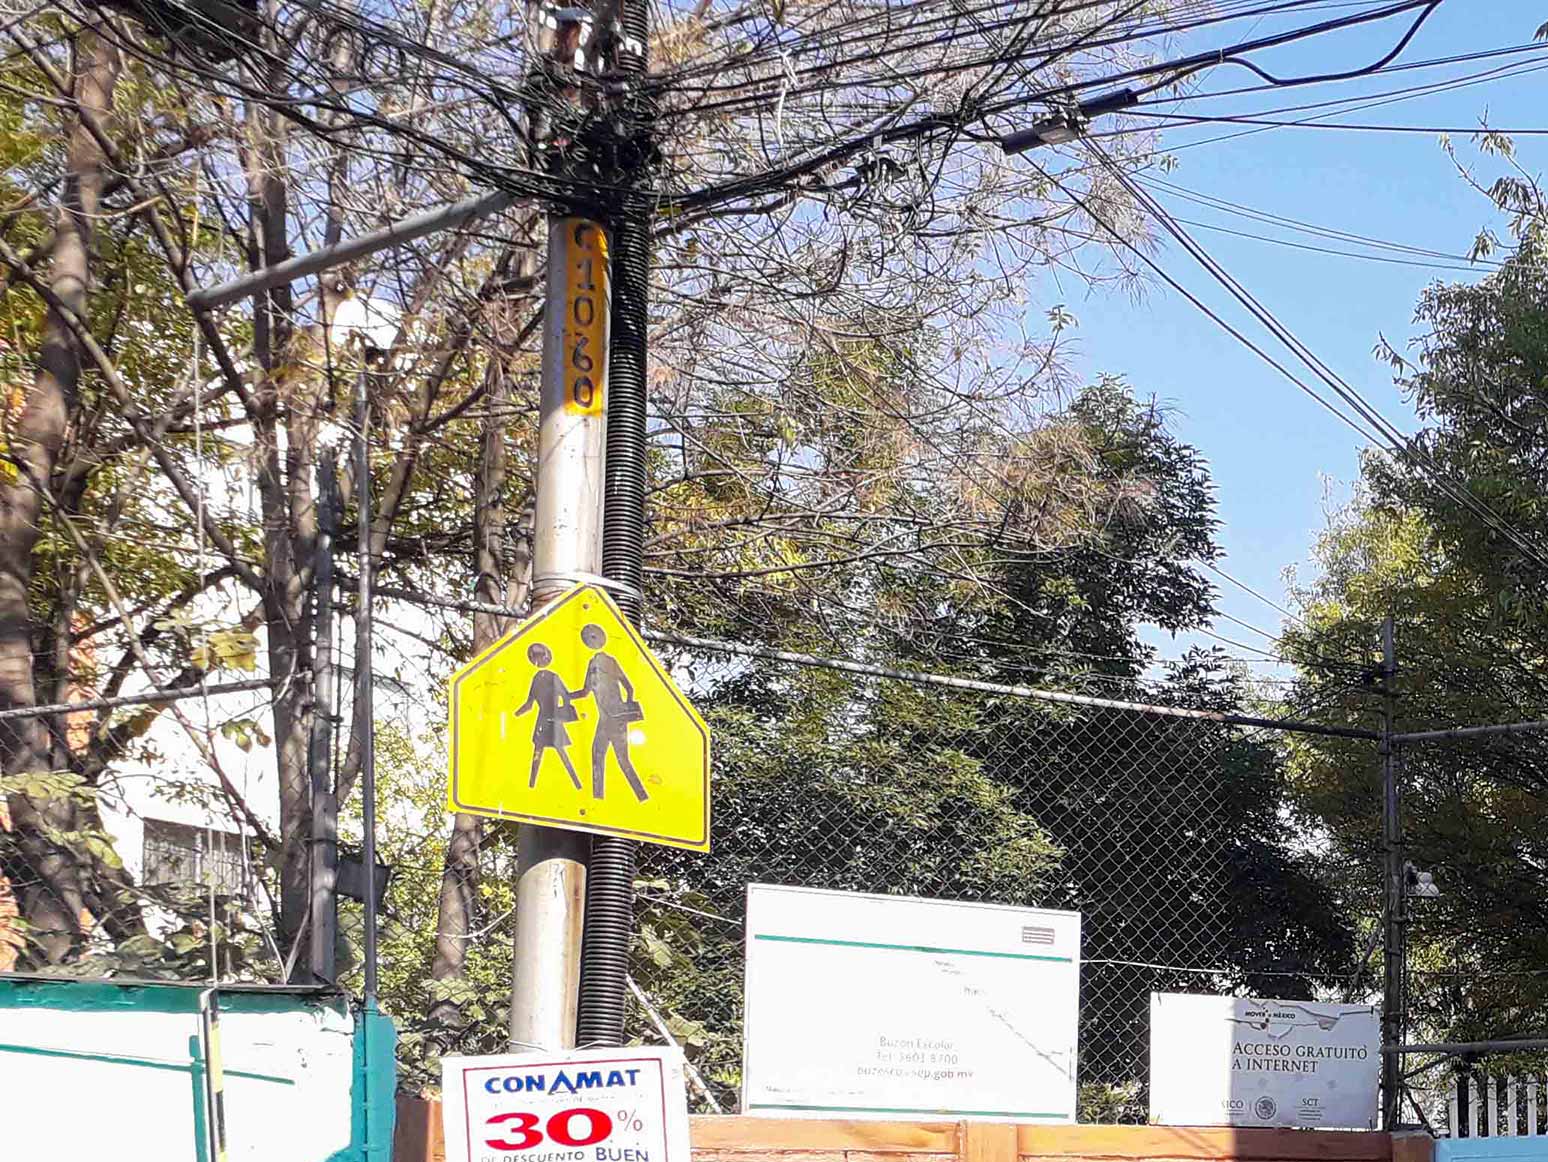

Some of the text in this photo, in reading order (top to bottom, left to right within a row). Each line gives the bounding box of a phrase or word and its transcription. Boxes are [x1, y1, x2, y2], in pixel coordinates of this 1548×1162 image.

[1233, 1042, 1368, 1060] ACCESO GRATUITO
[1232, 1059, 1318, 1073] A INTERNET
[484, 1069, 641, 1095] CONAMAT
[595, 1147, 648, 1162] BUEN
